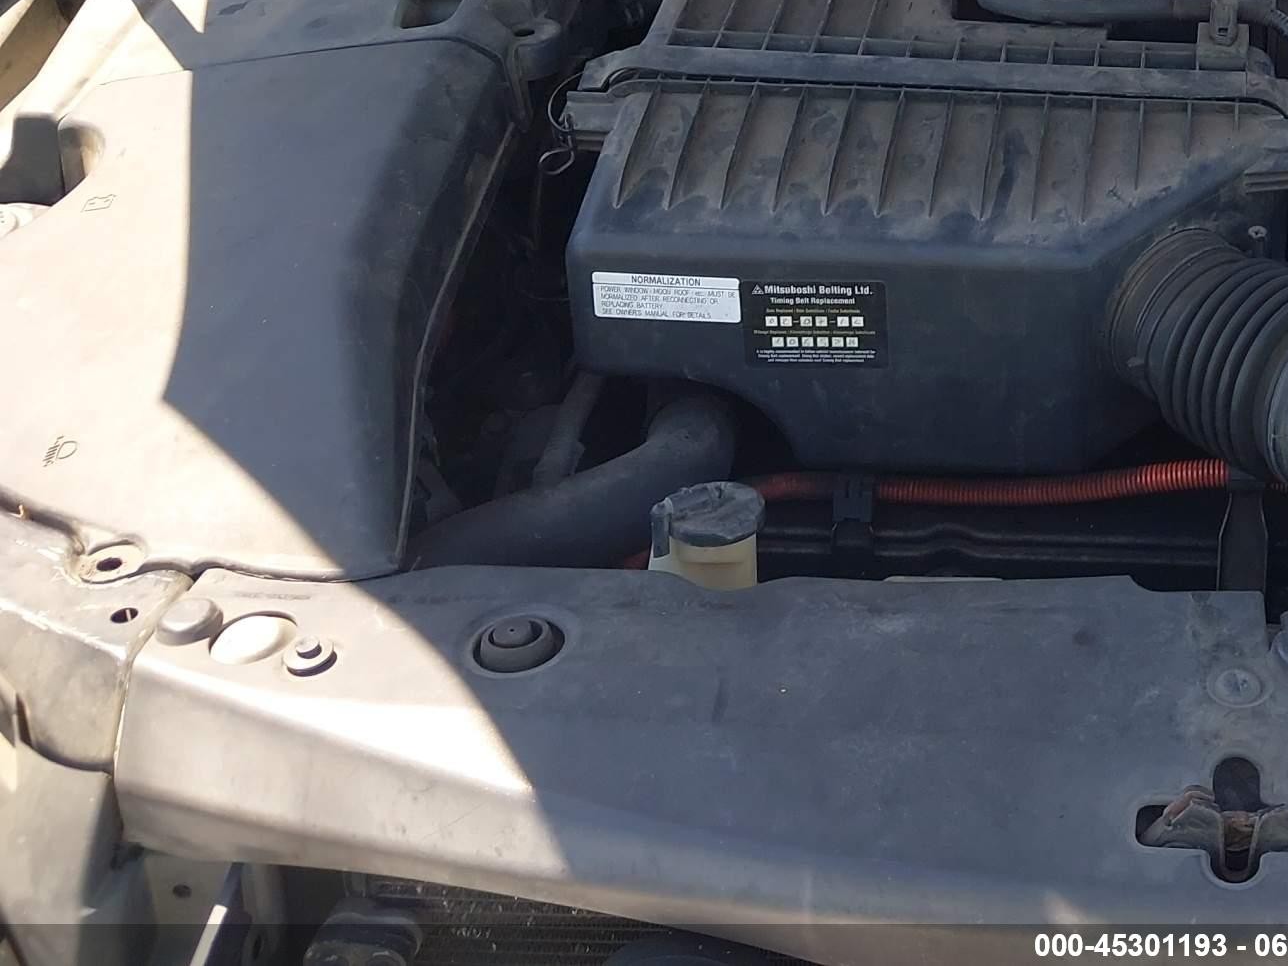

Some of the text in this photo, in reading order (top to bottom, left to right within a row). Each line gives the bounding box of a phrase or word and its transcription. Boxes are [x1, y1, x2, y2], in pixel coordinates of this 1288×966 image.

[631, 275, 701, 287] NORMALIZATION
[707, 290, 724, 298] MUST
[764, 284, 873, 296] Mitsuboshi Belting Ltd.
[600, 293, 638, 301] NORMALIZED
[663, 296, 707, 304] RECONNECTING
[770, 297, 794, 305] Timing
[810, 297, 856, 305] Replacement
[601, 301, 634, 309] REPLACING
